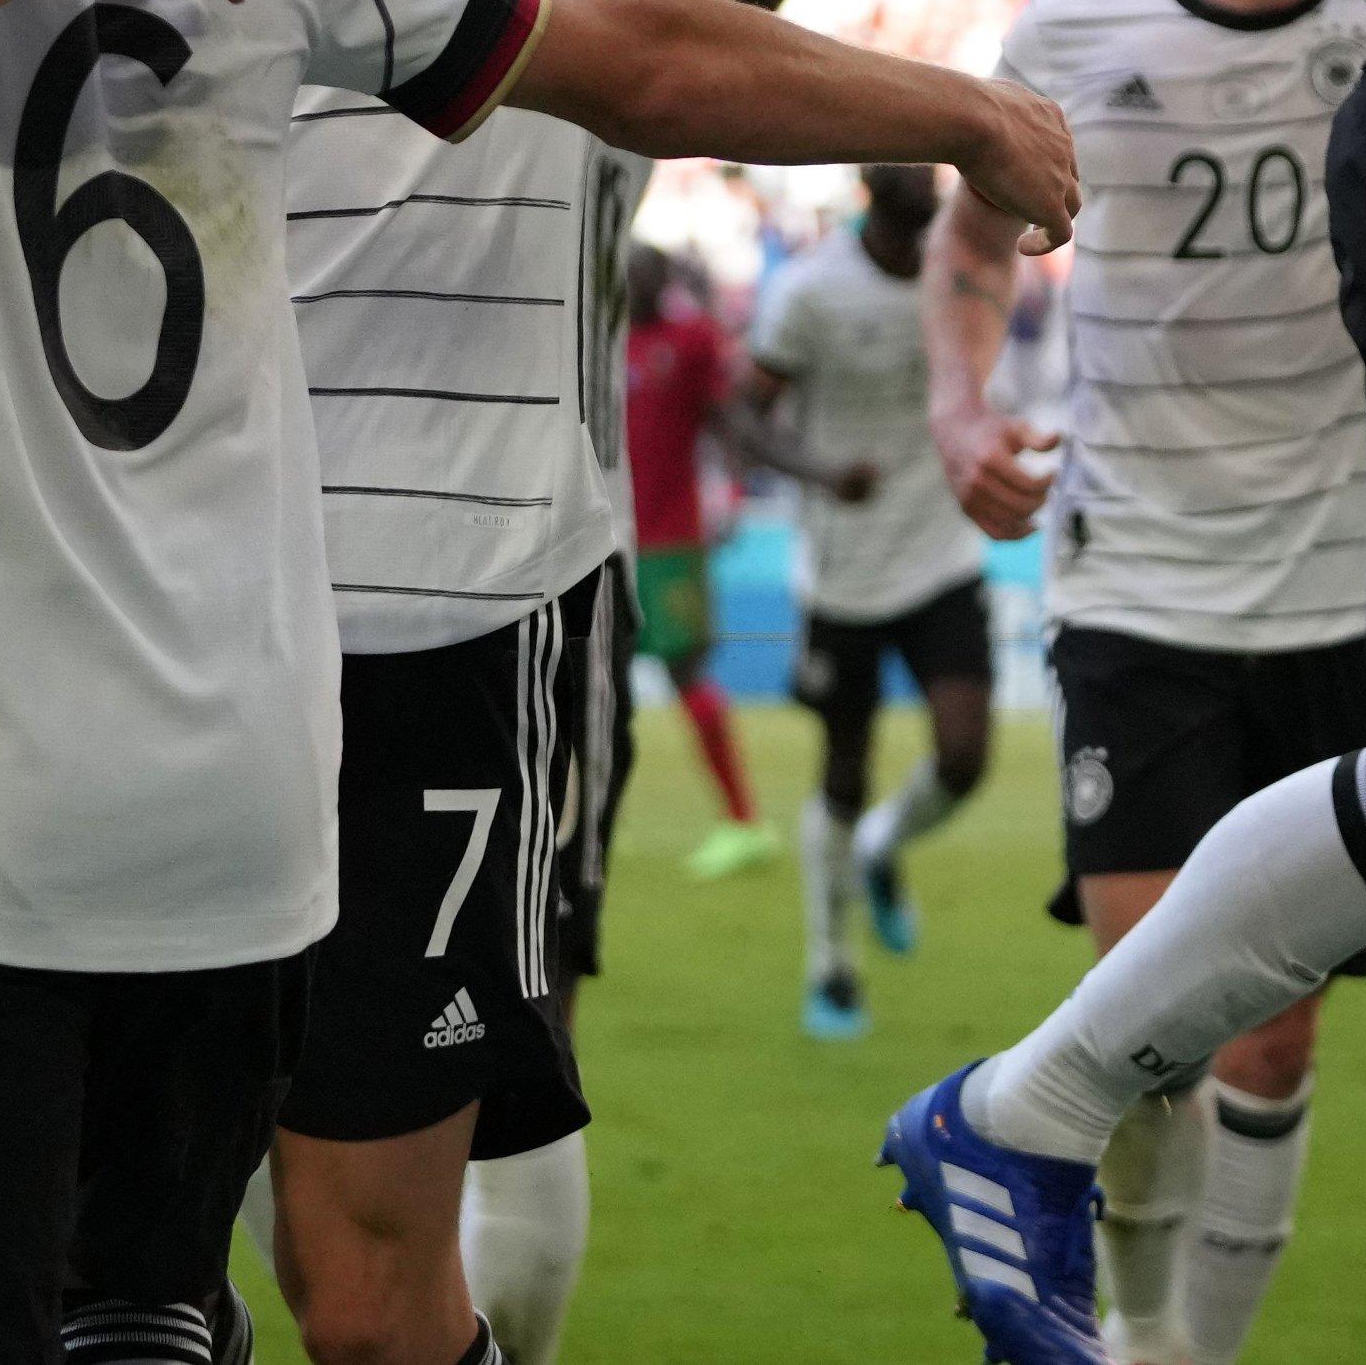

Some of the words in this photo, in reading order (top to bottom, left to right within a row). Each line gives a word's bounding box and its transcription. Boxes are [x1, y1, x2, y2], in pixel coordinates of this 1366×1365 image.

[13, 3, 205, 452] 6
[1168, 145, 1306, 260] 20
[423, 788, 502, 958] 7
[424, 1023, 485, 1048] adidas
